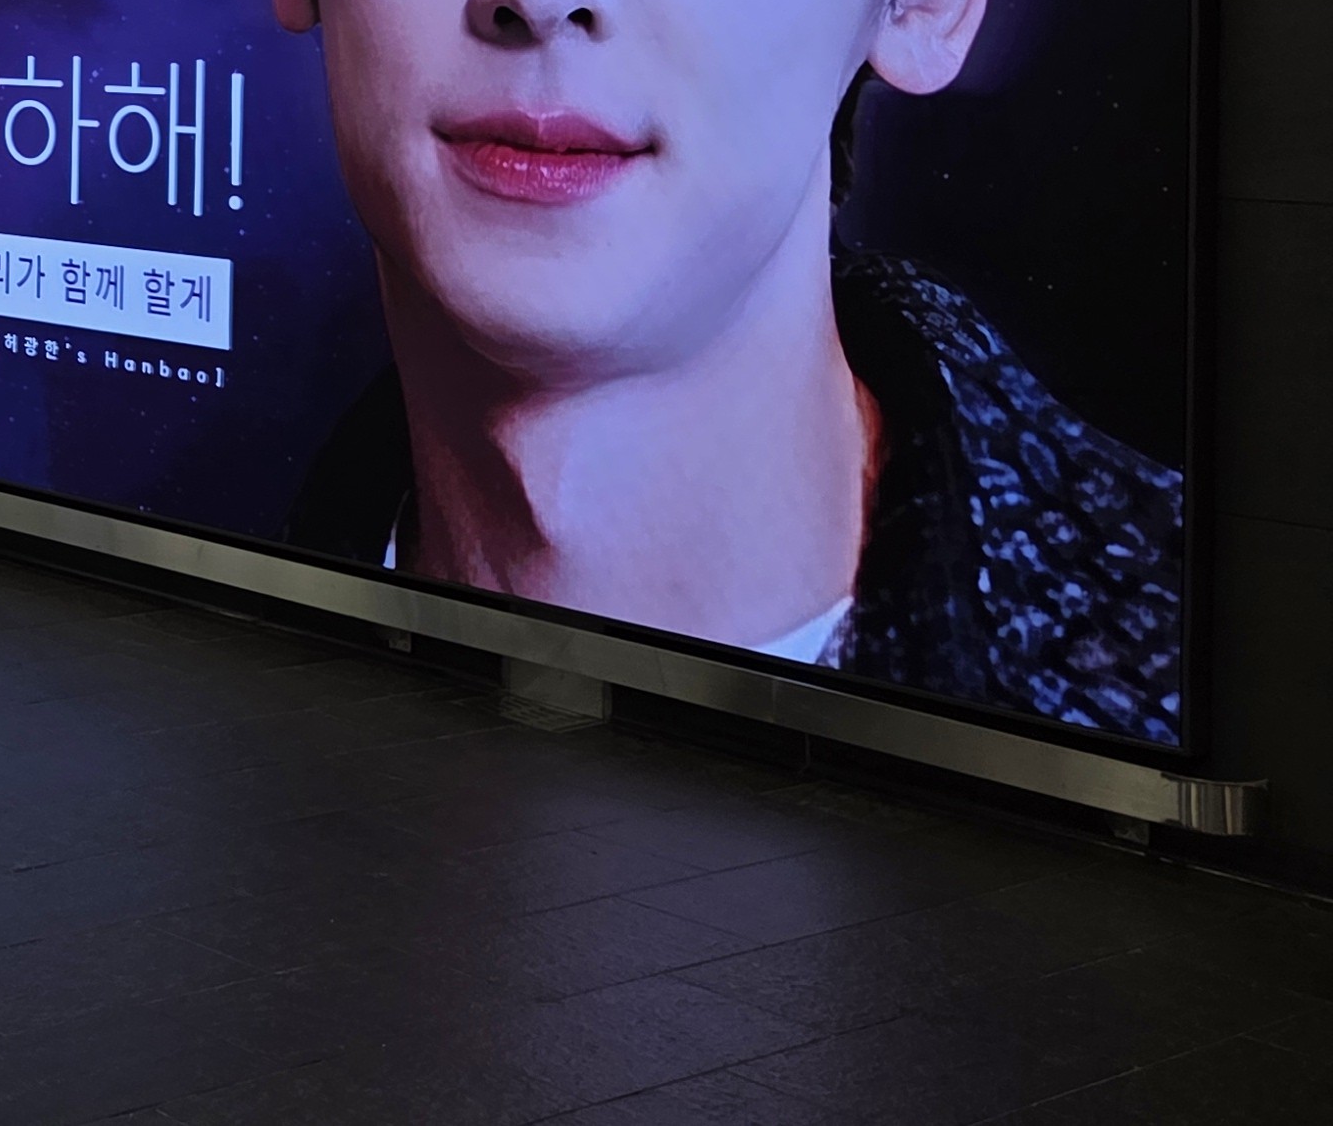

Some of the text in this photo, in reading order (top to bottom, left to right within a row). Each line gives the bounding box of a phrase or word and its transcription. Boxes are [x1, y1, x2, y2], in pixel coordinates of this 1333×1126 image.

[61, 258, 125, 311] 함께
[143, 268, 211, 323] 할게
[104, 350, 226, 389] Hanbao]
